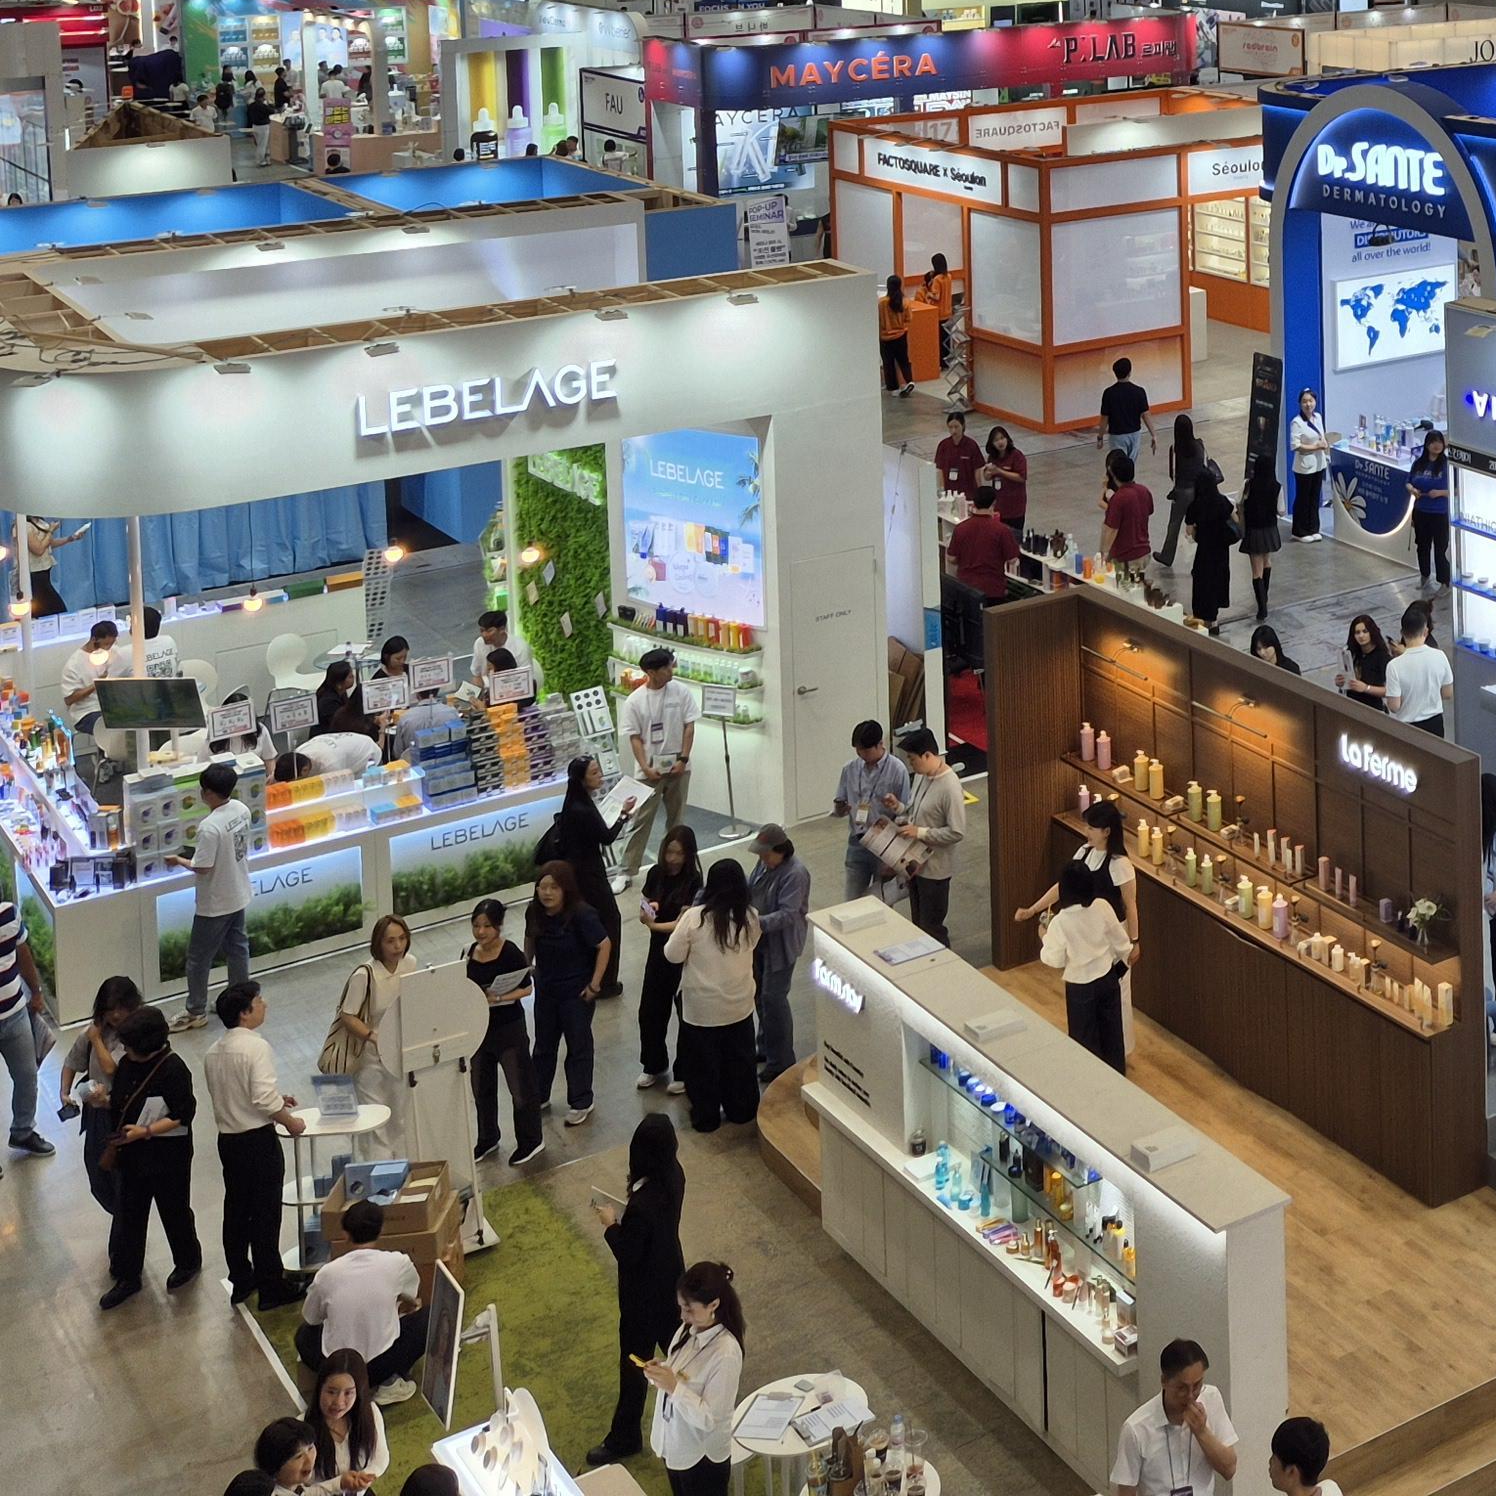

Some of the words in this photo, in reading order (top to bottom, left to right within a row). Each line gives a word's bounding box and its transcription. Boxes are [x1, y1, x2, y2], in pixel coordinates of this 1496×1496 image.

[770, 51, 937, 88] MAYCÉRA
[605, 93, 623, 114] FAU
[715, 107, 799, 126] AYCERA
[877, 153, 941, 178] FACTOSQUARE
[950, 166, 987, 187] Séoulon
[1322, 184, 1446, 219] DERMATOLOGY
[1351, 252, 1362, 263] all
[1364, 251, 1381, 261] over
[1386, 247, 1400, 258] the
[1403, 244, 1431, 255] world!
[357, 358, 618, 437] LEBELAGE
[650, 459, 725, 489] LEBELAGE
[815, 613, 833, 623] STAFF
[835, 609, 852, 620] ONLY
[431, 812, 529, 851] LEBELAGE
[249, 867, 313, 897] ELAGE
